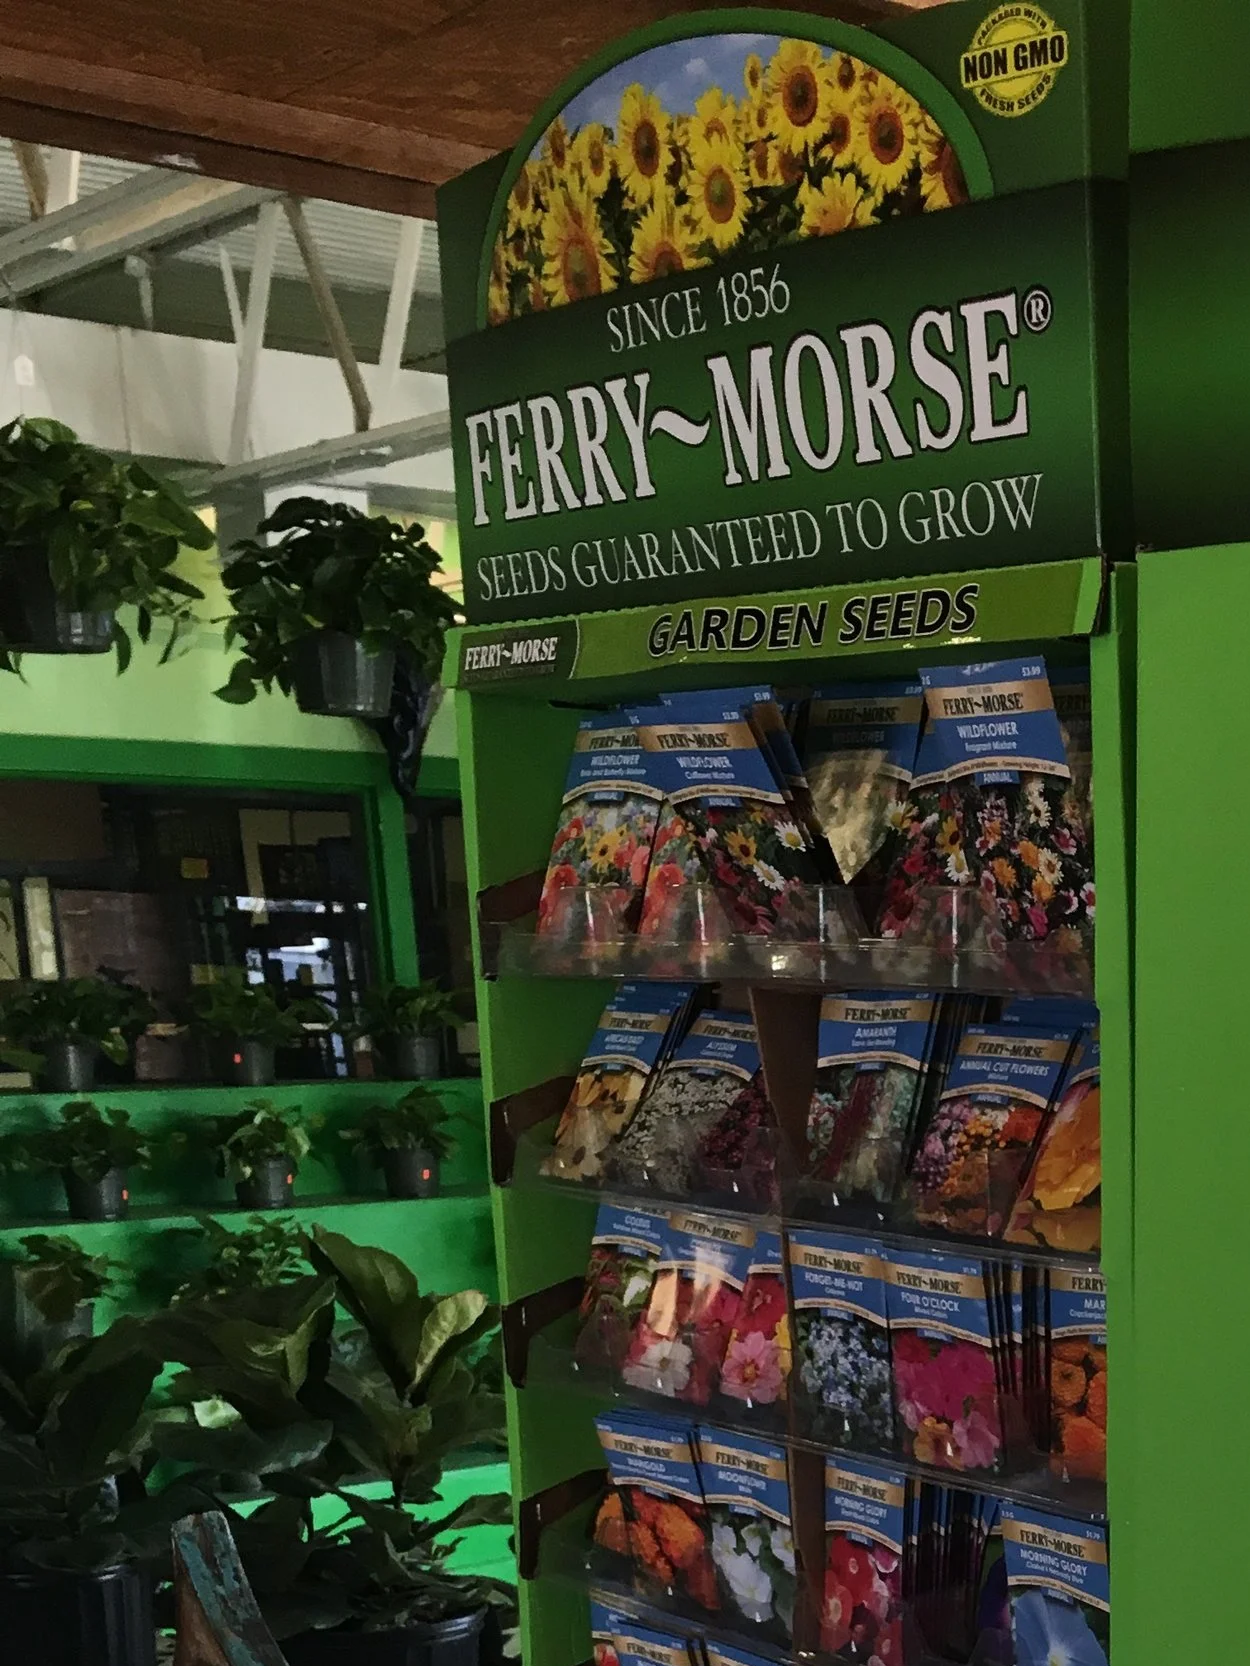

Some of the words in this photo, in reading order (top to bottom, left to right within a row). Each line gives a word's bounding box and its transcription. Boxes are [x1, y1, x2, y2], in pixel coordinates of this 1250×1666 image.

[964, 48, 1008, 83] NON
[1014, 35, 1064, 71] GMO
[980, 88, 1014, 112] FRESH
[1018, 72, 1051, 109] SEEDS
[606, 288, 706, 353] SINCE
[716, 263, 791, 326] 1856
[477, 546, 565, 601] SEEDS
[571, 508, 821, 586] GUARANTEED
[826, 498, 888, 552] TO
[899, 474, 1043, 546] GROW
[647, 602, 826, 657] GARDEN
[838, 583, 980, 643] SEEDS
[957, 721, 1019, 738] WILDFLOWER
[590, 754, 640, 766] WILDFLOWER
[676, 756, 734, 768] WILDFLOWER
[983, 772, 1013, 783] ANNUAL
[959, 1060, 992, 1072] ANNUAL
[993, 1063, 1010, 1073] CUT
[1011, 1063, 1050, 1077] FLOWERS
[900, 1291, 922, 1304] FOUR
[1020, 1549, 1059, 1567] MORNING
[1061, 1560, 1088, 1576] GLORY
